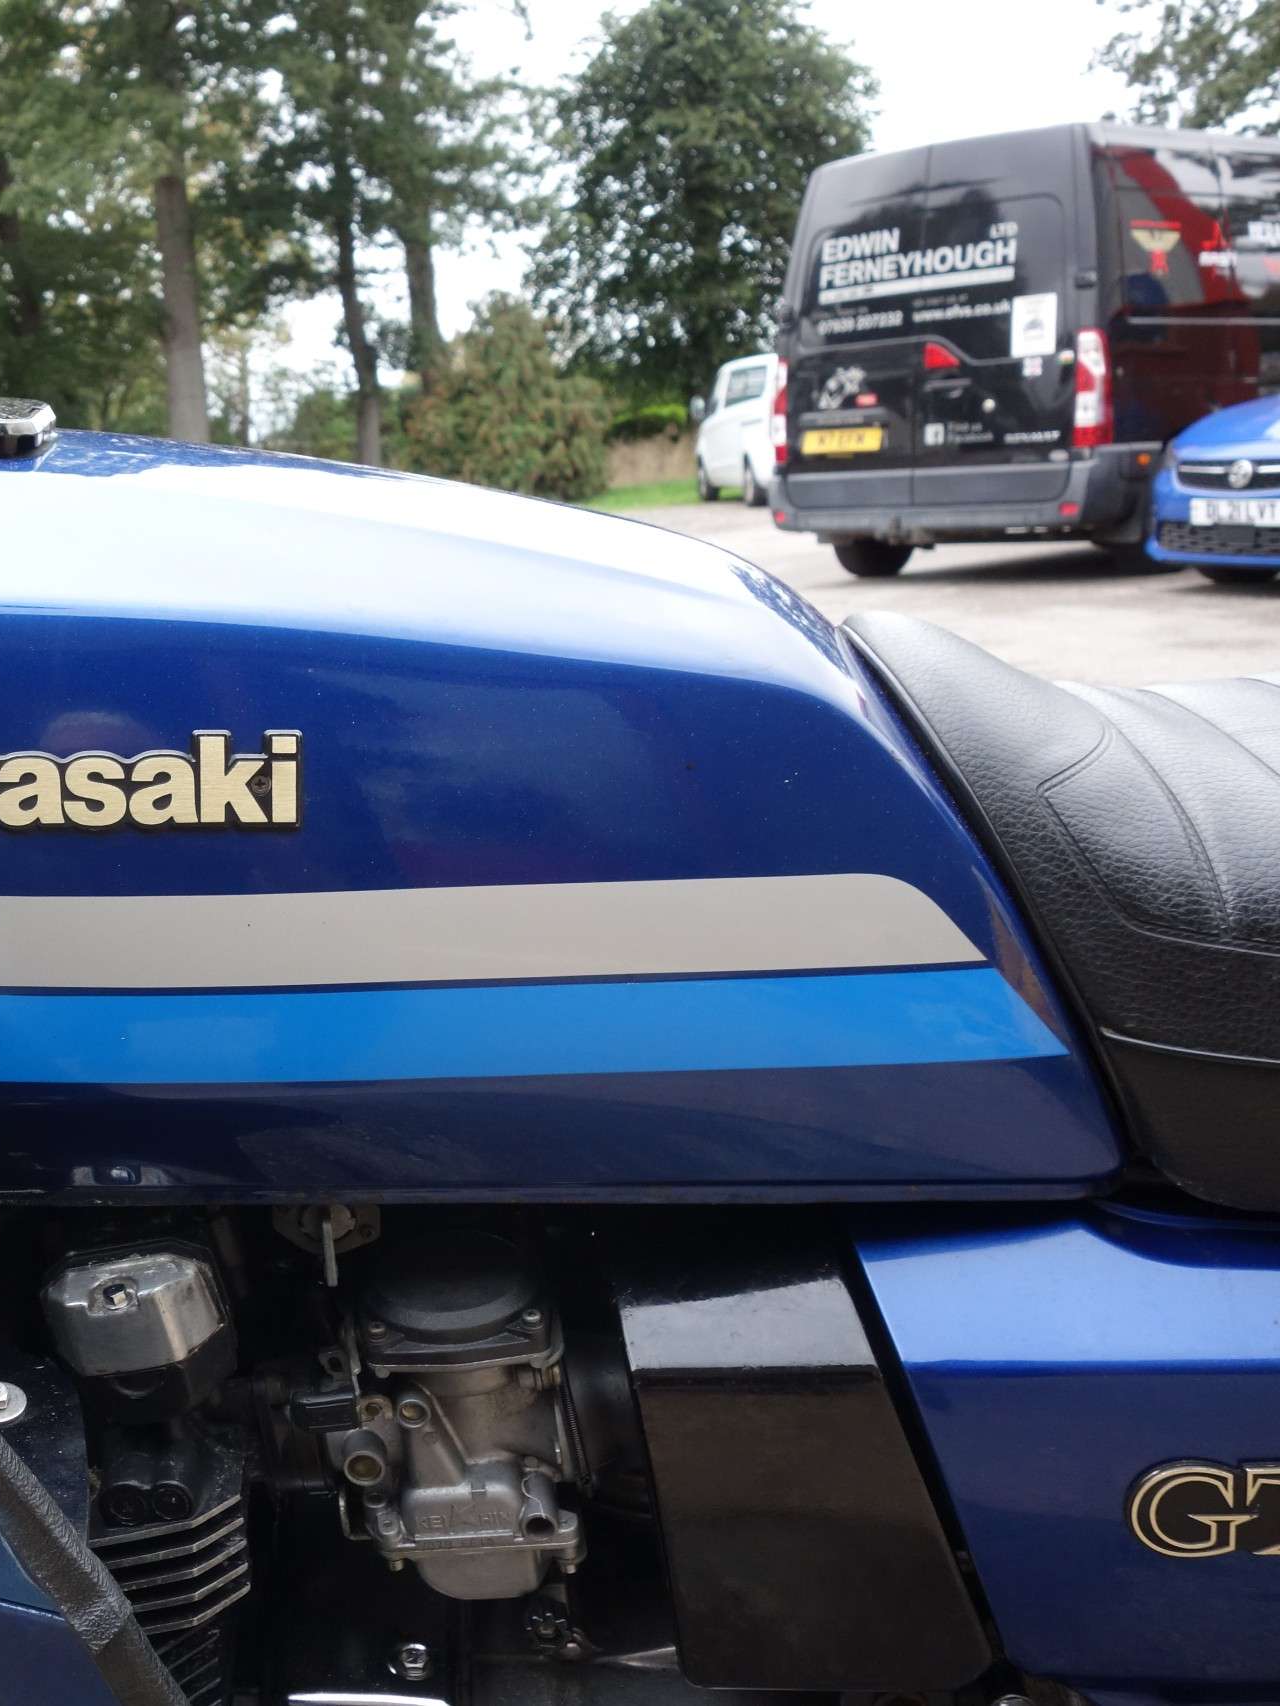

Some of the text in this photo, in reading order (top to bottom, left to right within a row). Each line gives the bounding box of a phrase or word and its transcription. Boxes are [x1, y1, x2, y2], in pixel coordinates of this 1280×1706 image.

[821, 227, 901, 264] EDWIN
[990, 221, 1018, 239] LTD
[820, 238, 1018, 290] FERNEYHOUGH
